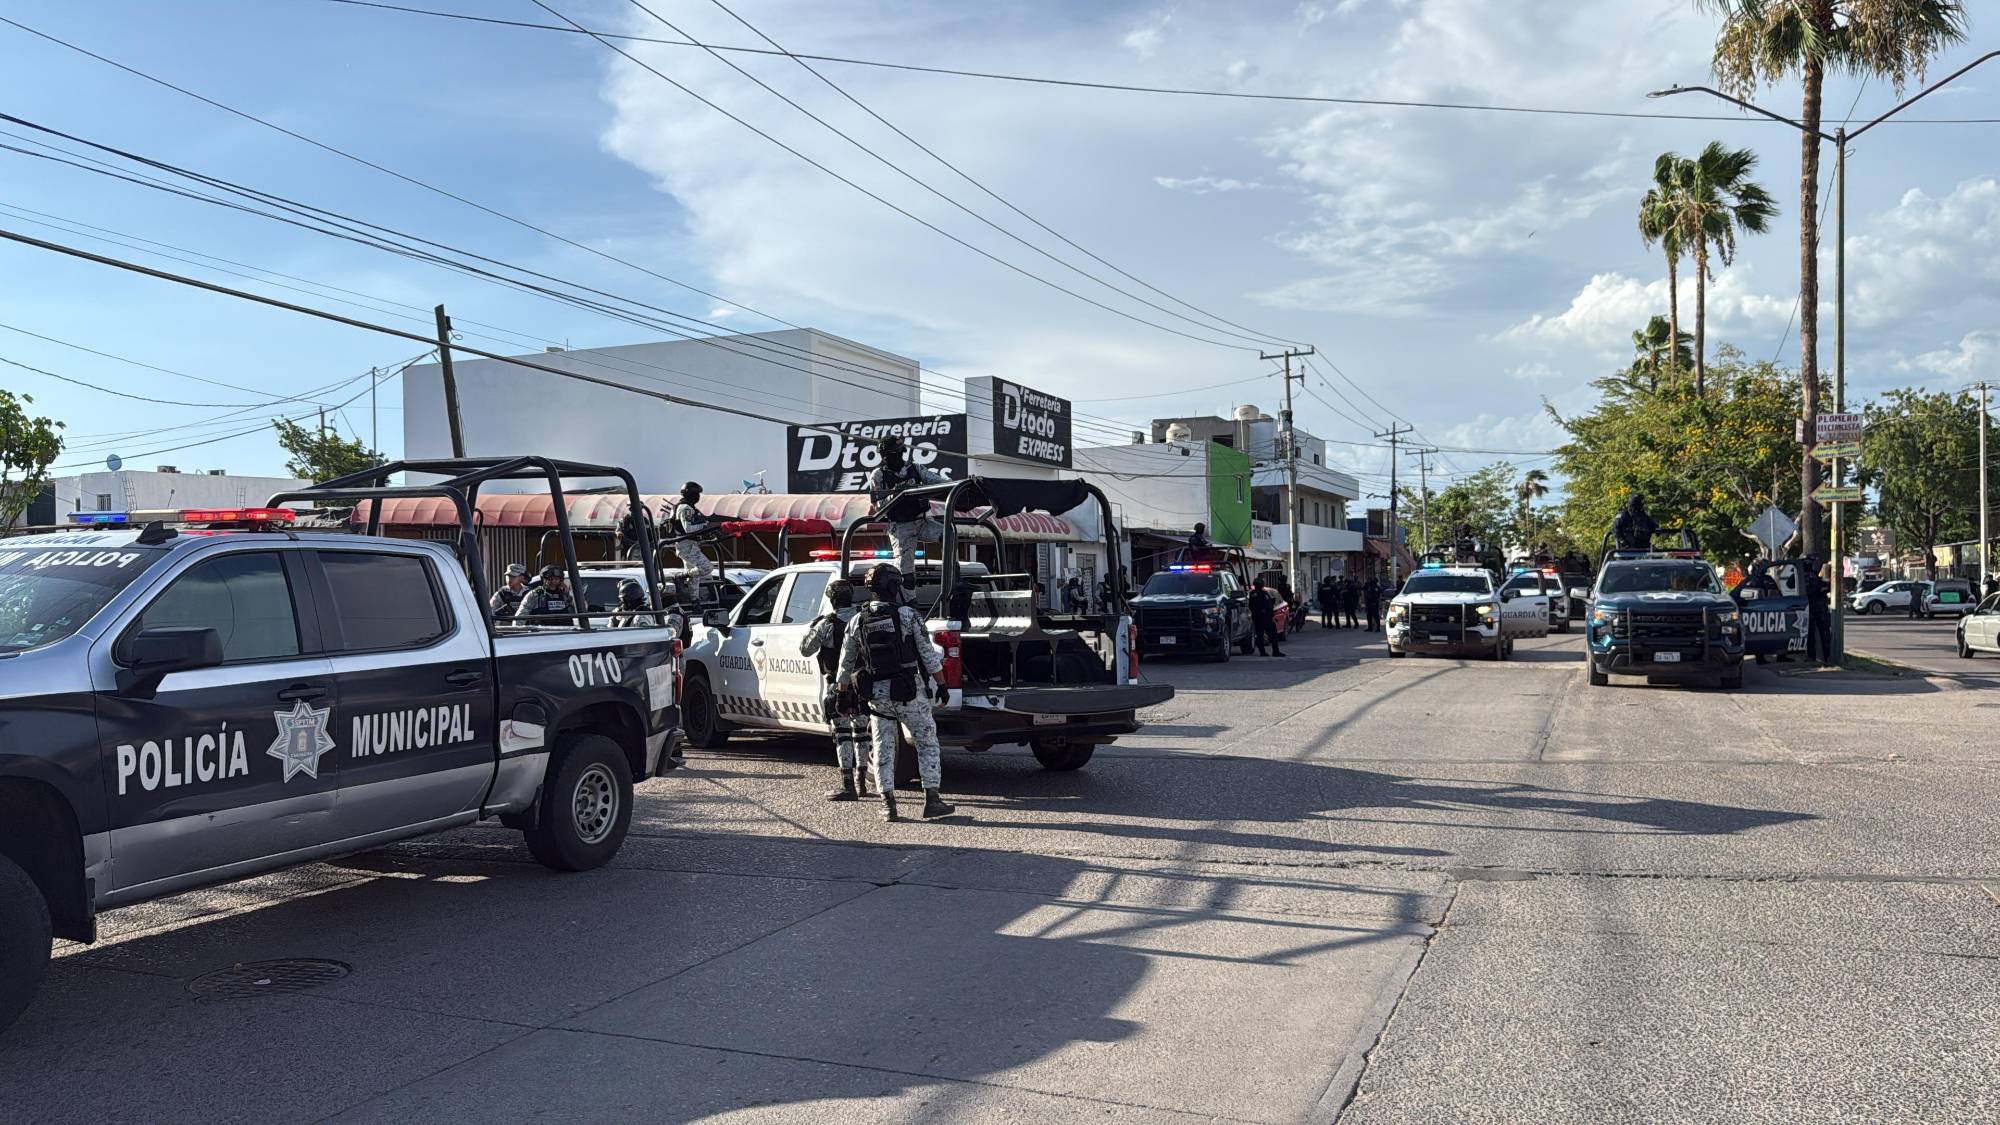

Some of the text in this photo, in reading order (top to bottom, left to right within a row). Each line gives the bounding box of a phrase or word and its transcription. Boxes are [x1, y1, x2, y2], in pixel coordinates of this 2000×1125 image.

[849, 416, 951, 438] Ferretería
[1818, 415, 1858, 423] PLOMERO
[1018, 436, 1064, 462] EXPRESS
[1502, 611, 1536, 619] GUARDIA
[568, 651, 622, 688] 0710
[719, 656, 813, 675] GUARDIA NACIONAL
[351, 703, 475, 758] MUNICIPAL
[117, 721, 249, 796] POLICÍA
